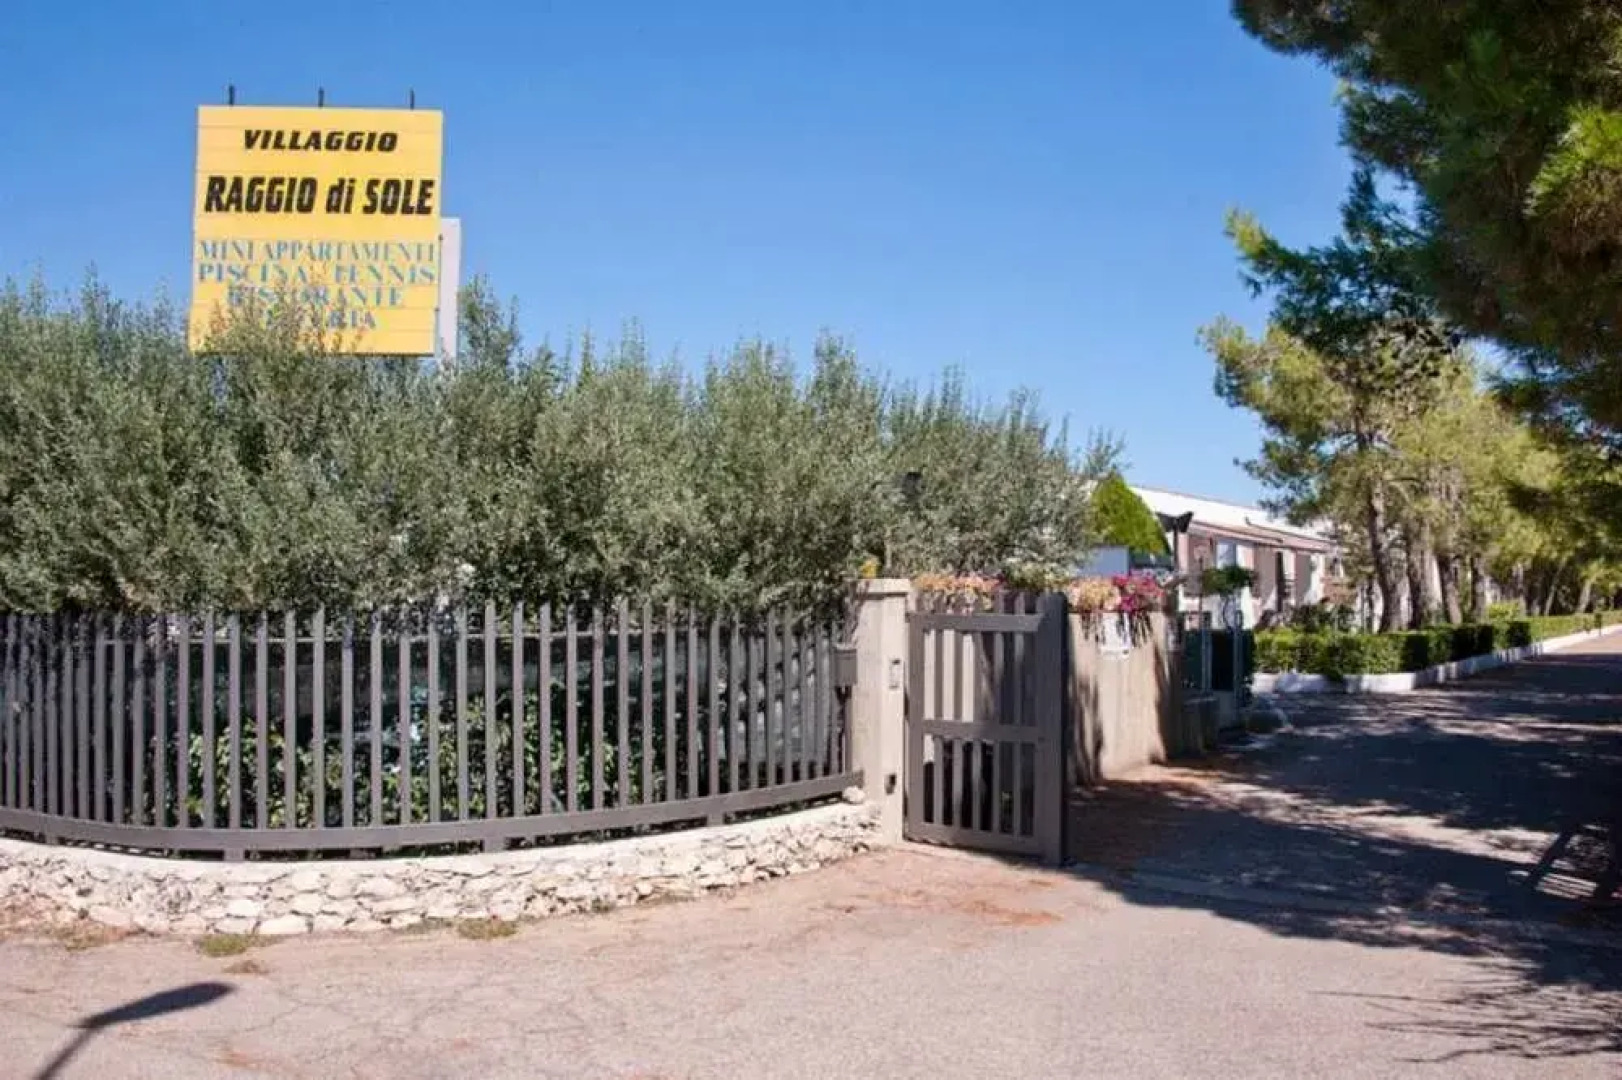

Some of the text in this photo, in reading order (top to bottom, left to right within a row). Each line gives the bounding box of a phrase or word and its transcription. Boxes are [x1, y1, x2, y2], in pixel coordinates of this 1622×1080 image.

[245, 130, 398, 152] VILLAGGIO
[204, 176, 434, 215] RAGGIO di SOLE
[199, 240, 435, 262] MINI APPARTAMENTI
[199, 263, 435, 284] PISCINA TENNIS
[227, 285, 404, 308] RSORANTE
